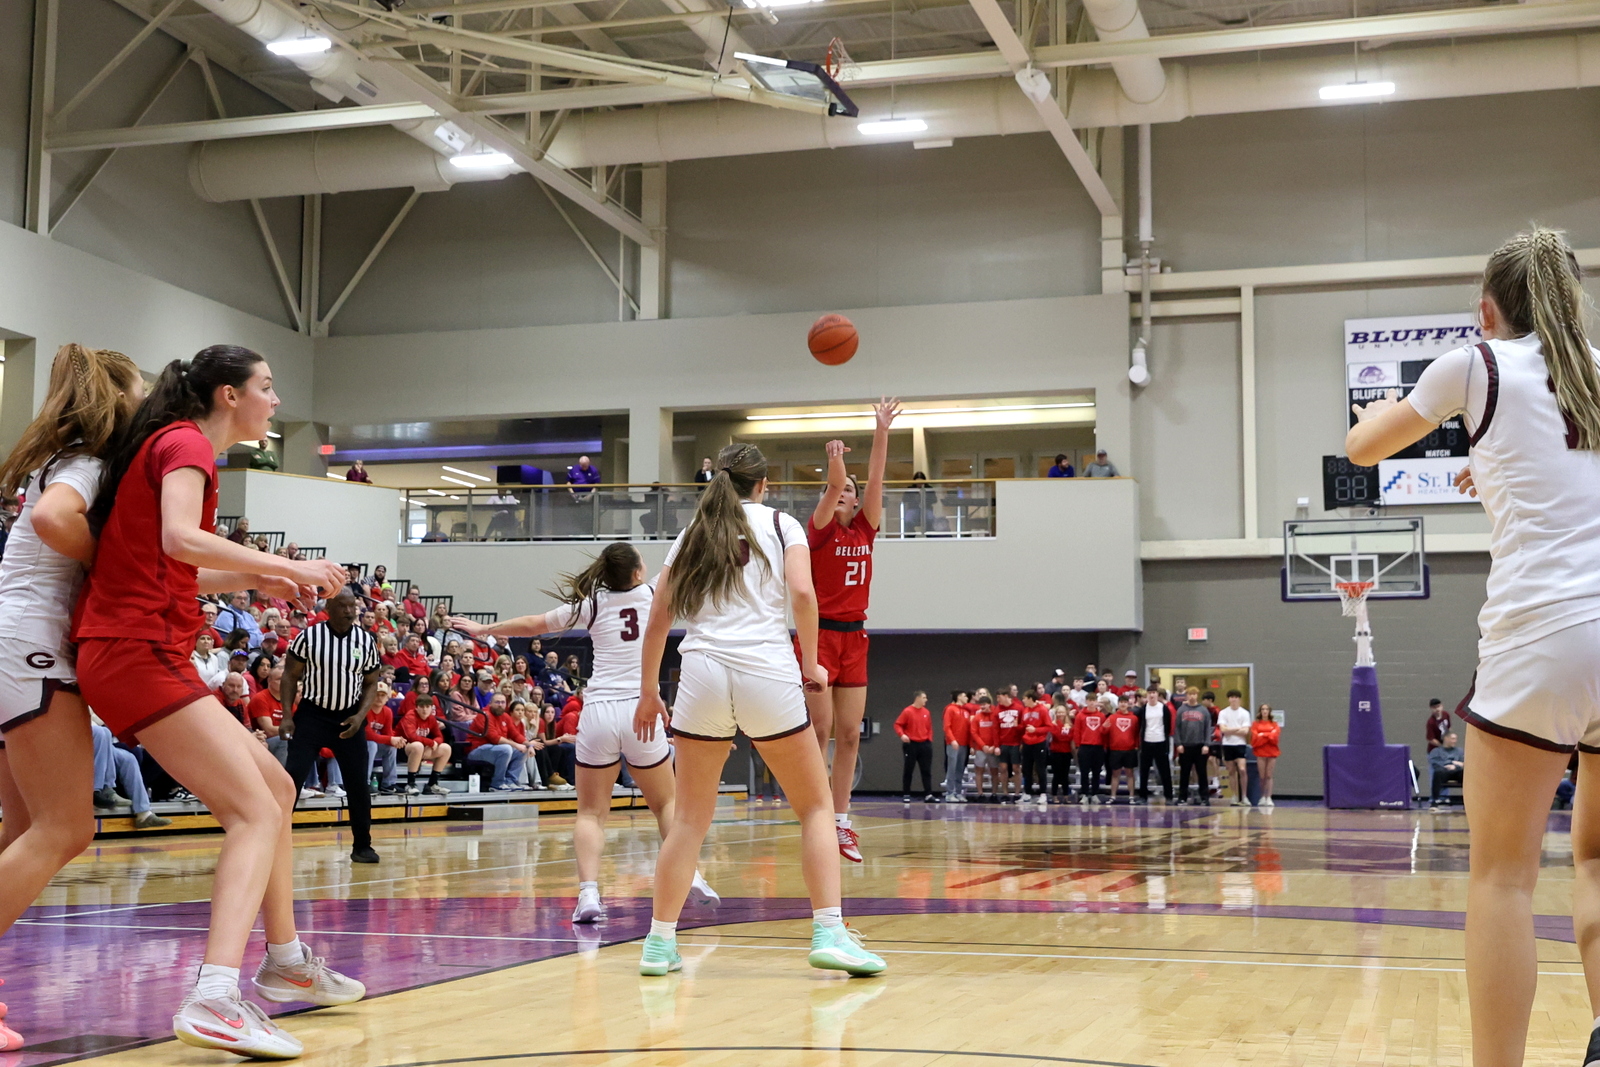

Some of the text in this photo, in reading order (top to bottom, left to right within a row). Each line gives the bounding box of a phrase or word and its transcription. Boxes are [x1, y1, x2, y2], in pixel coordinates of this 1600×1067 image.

[1358, 338, 1482, 350] UNIVERSI
[1352, 388, 1404, 400] BLUFFTN
[1425, 449, 1451, 458] MATCH
[844, 560, 867, 586] 21
[619, 607, 640, 642] 3
[26, 652, 56, 669] G
